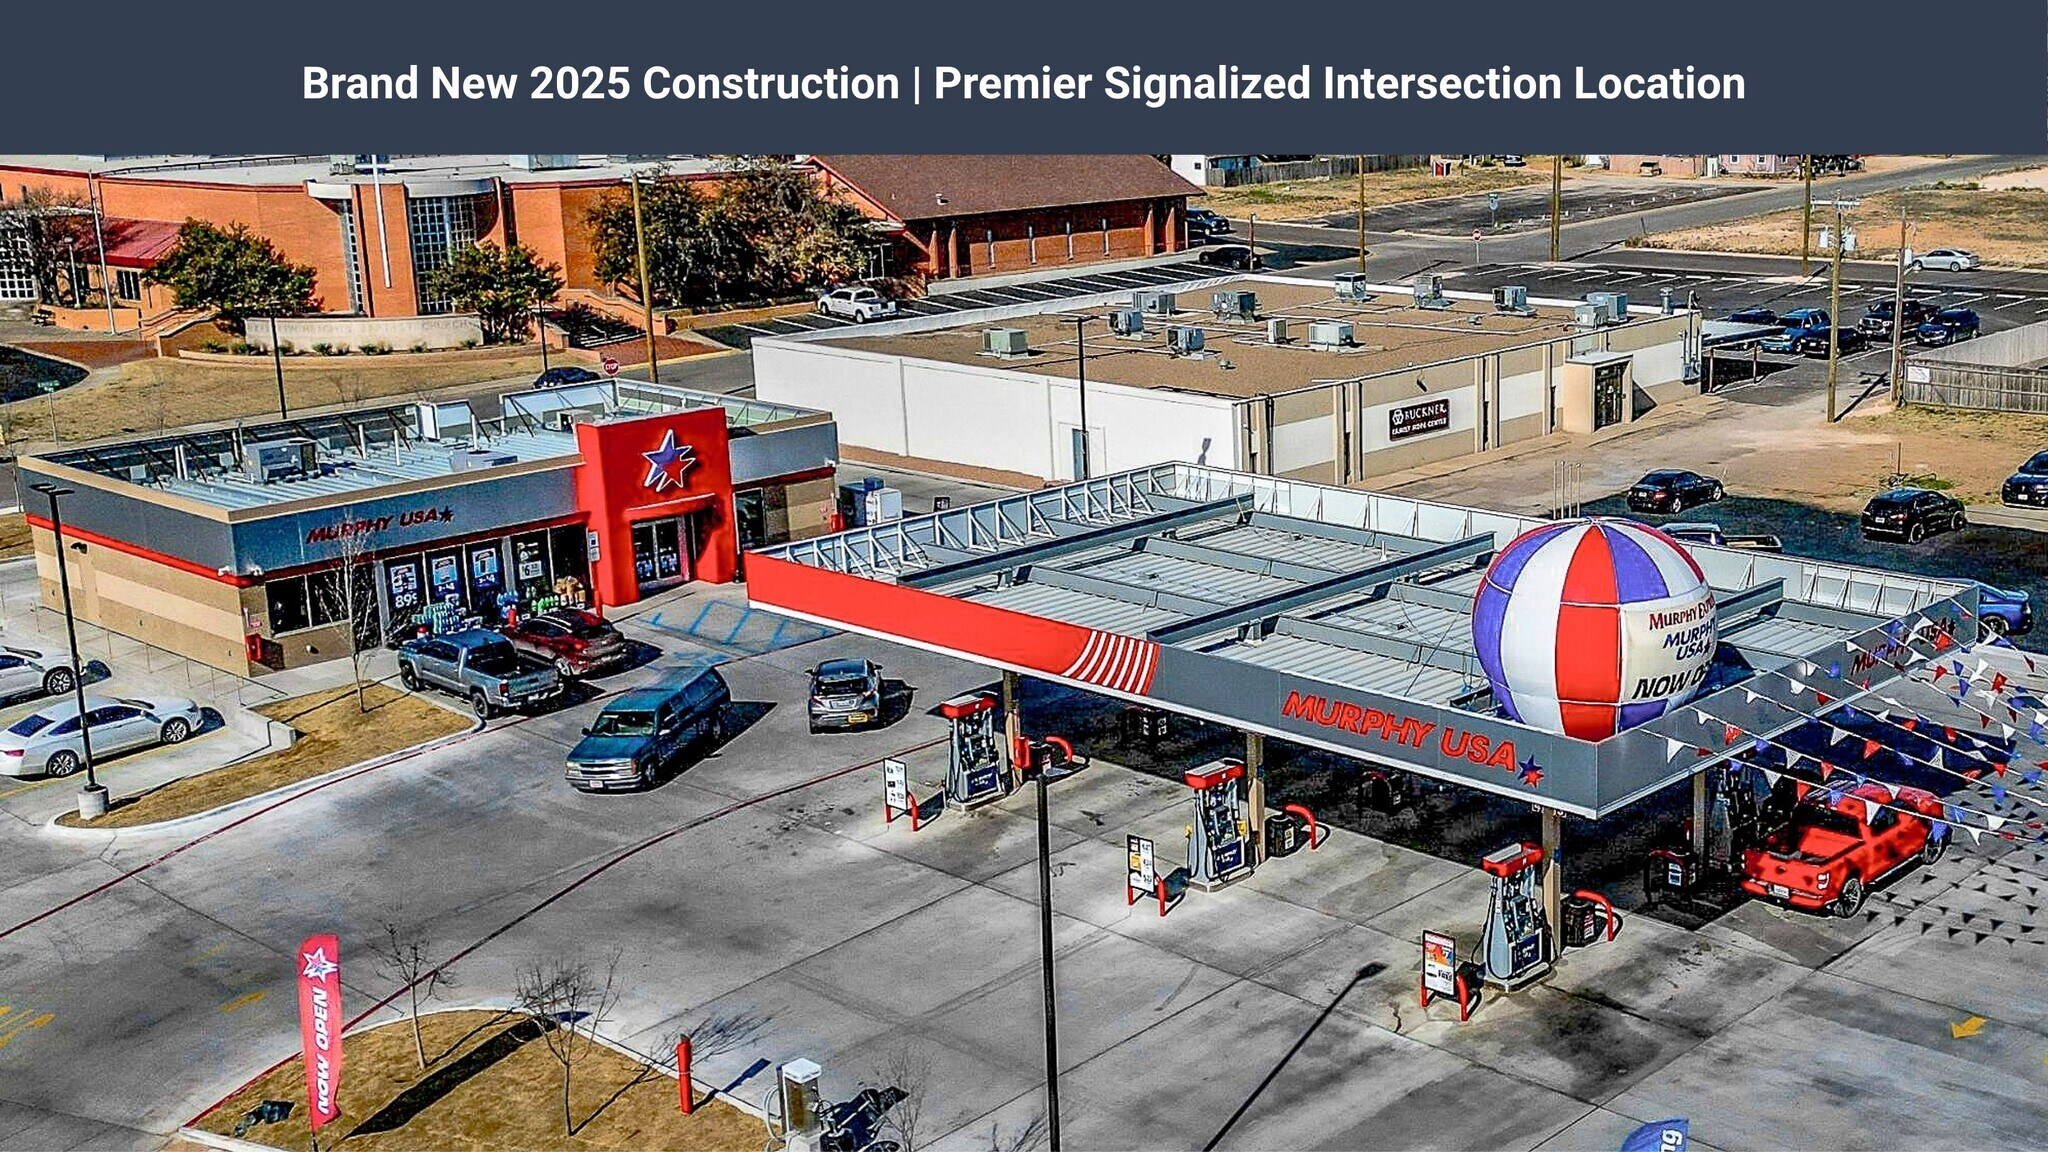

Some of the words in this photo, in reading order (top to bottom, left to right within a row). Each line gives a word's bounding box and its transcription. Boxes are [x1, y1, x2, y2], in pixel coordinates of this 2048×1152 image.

[1404, 404, 1447, 420] BUCKNER
[306, 515, 394, 544] MURPHY
[400, 508, 438, 527] USA
[1676, 640, 1703, 660] USA
[1632, 669, 1692, 700] NOW
[1282, 690, 1436, 748] MURPHY
[1440, 727, 1516, 773] USA
[312, 986, 329, 1052] OPEN
[316, 1053, 330, 1115] NOW
